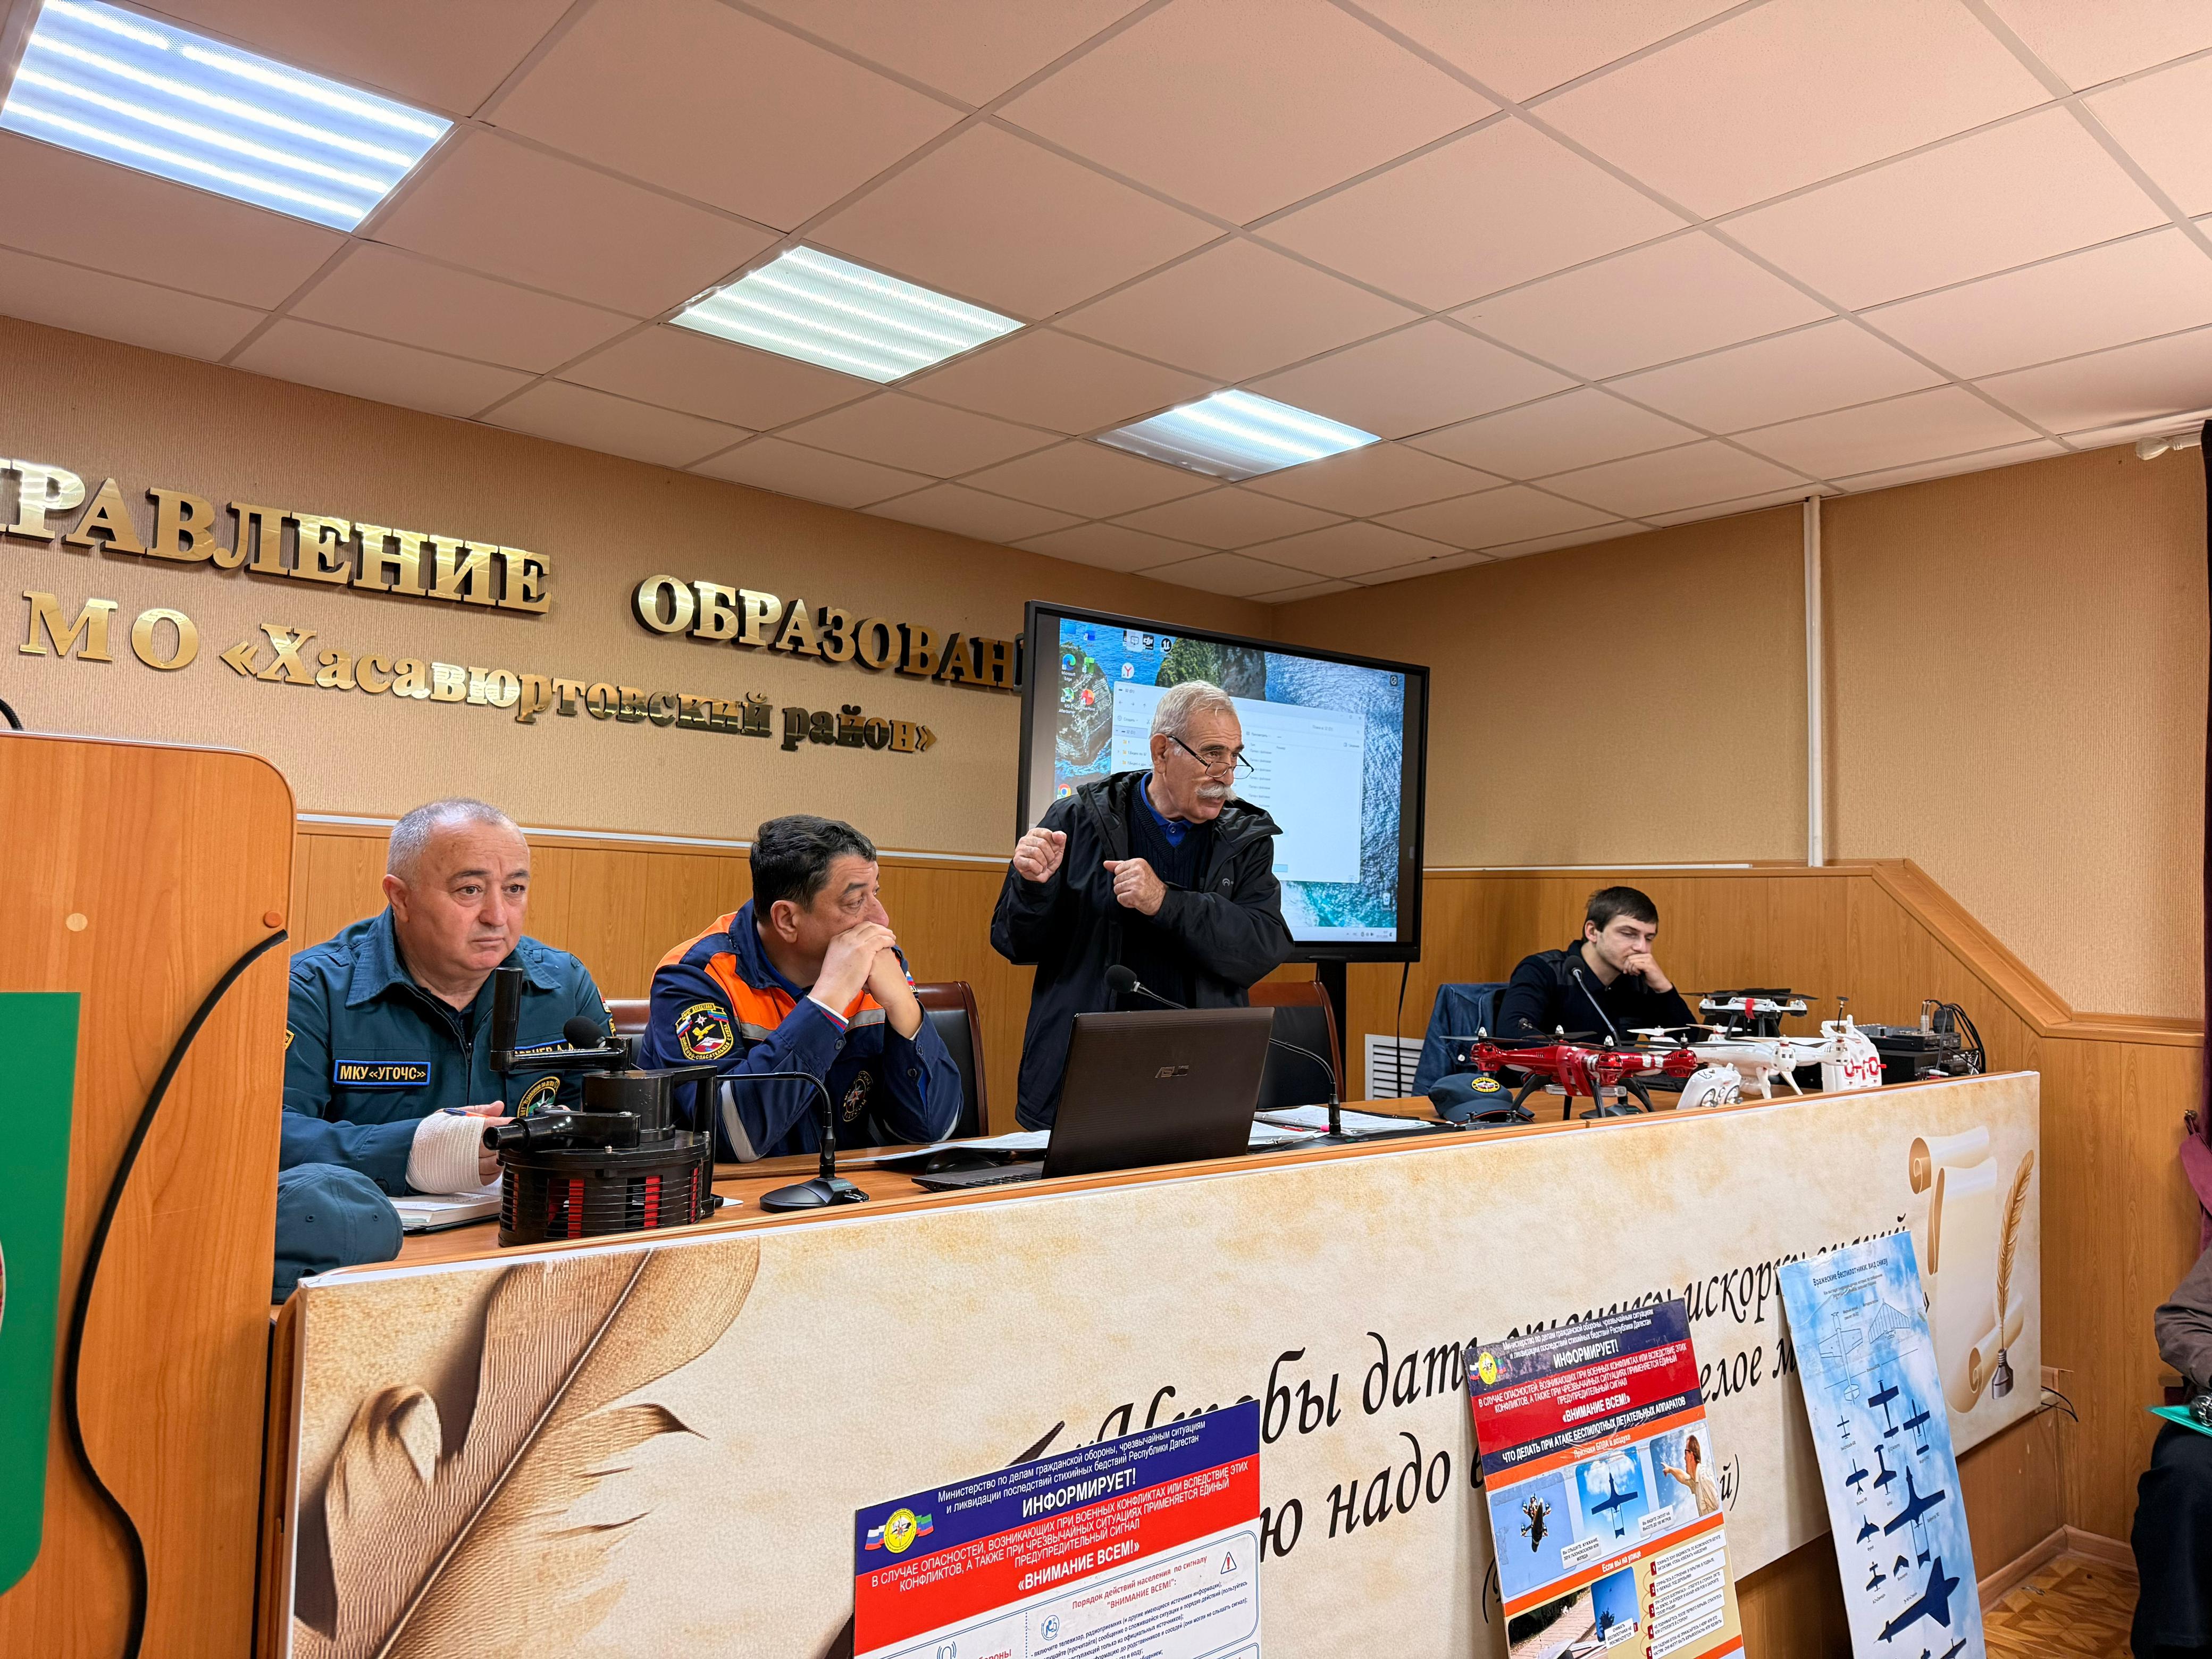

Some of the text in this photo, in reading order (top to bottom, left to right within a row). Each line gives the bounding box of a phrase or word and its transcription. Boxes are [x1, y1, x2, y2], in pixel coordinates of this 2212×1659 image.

[633, 574, 1024, 691] ОБРАЗОВАН
[221, 623, 773, 738] «Хасавюртовский
[781, 704, 937, 752] район»
[1813, 1273, 1837, 1287] Вражеские
[1868, 1261, 1877, 1270] вид
[1877, 1258, 1888, 1267] снизу
[1363, 1332, 1478, 1414] дат
[1685, 1252, 1805, 1323] искор
[1503, 1336, 1534, 1351] Министерство
[1541, 1331, 1555, 1341] делам
[1555, 1323, 1582, 1338] гражданской
[1583, 1320, 1602, 1331] обороны,
[1603, 1313, 1632, 1327] чрезвычайным
[1633, 1309, 1653, 1319] ситуациям
[1514, 1347, 1539, 1358] ликвидации
[1540, 1339, 1568, 1353] последствий
[1568, 1333, 1590, 1345] стихийных
[1591, 1327, 1610, 1338] бедствий
[1610, 1323, 1633, 1335] Республики
[1634, 1319, 1652, 1330] Дагестан
[1554, 1339, 1619, 1368] ИНФОРМИРУЕТ!
[1478, 1399, 1482, 1407] В
[1483, 1393, 1503, 1406] СЛУЧАЕ
[1504, 1384, 1539, 1401] ОПАСНОСТЕЙ,
[1539, 1374, 1576, 1390] ВОЗНИКАЮЩИХ
[1577, 1371, 1587, 1381] ПРИ
[1587, 1364, 1610, 1378] ВОЕННЫХ
[1610, 1357, 1638, 1371] КОНФЛИКТАХ
[1648, 1347, 1675, 1360] ВСЛЕДСТВИЕ
[1675, 1343, 1687, 1352] ЭТИХ
[1495, 1396, 1530, 1413] КОНФЛИКТОВ,
[1534, 1389, 1551, 1402] ТАКЖЕ
[1551, 1387, 1561, 1397] ПРИ
[1561, 1374, 1601, 1393] ЧРЕЗВЫЧАЙНЫХ
[1601, 1369, 1627, 1383] СИТУАЦИЯХ
[1627, 1360, 1659, 1376] ПРИМЕНЯЕТСЯ
[1659, 1354, 1677, 1367] ЕДИНЫЙ
[1557, 1378, 1627, 1404] ПРЕДУПРЕДИТЕЛЬНЫЙ СИГНАЛ
[1502, 1396, 1686, 1463] ЧТО ДЕЛАТЬ ПРИ АТАКЕ БЕСПИЛОТНЫХ ЛЕТАТЕЛЬНЫХ АППАРАТОВ
[1563, 1393, 1630, 1422] «ВНИМАНИЕ ВСЕМ!»
[938, 1421, 1205, 1503] Министерство по делам гражданской обороны, чрезвычайным ситуациям
[1595, 1439, 1609, 1451] БПЛА
[1613, 1434, 1631, 1445] воздухе
[946, 1435, 1199, 1514] и ликвидации последствий стихийных бедствий Республики Дагестан
[1023, 1468, 1136, 1518] ИНФОРМИРУЕТ!
[1326, 1432, 1450, 1539] надо
[872, 1461, 1249, 1587] В СЛУЧАЕ ОПАСНОСТЕЙ, ВОЗНИКАЮЩИХ ПРИ ВОЕННЫХ КОНФЛИКТАХ ИЛИ ВСЛЕДСТВИЕ ЭТИХ
[900, 1478, 1229, 1592] КОНФЛИКТОВ, А ТАКЖЕ ПРИ ЧРЕЗВЫЧАЙНЫХ СИТУАЦИЯХ ПРИМЕНЯЕТСЯ ЕДИНЫЙ
[1015, 1519, 1139, 1568] ПРЕДУПРЕДИТЕЛЬНЫЙ СИГНАЛ
[1018, 1539, 1139, 1591] «ВНИМАНИЕ ВСЕМ!»
[1073, 1594, 1103, 1610] Порядок
[1104, 1580, 1135, 1599] действий
[1137, 1569, 1170, 1586] населения
[1183, 1556, 1207, 1570] сигналу
[1602, 1561, 1613, 1572] Если
[1614, 1560, 1621, 1568] вы
[1628, 1551, 1641, 1563] улице
[1067, 1637, 1097, 1655] (прочитайте)
[1098, 1629, 1124, 1642] сообщение
[1128, 1615, 1159, 1630] сложившейся
[1160, 1607, 1179, 1619] ситуации
[1184, 1599, 1201, 1611] порядке
[1202, 1590, 1220, 1603] действий
[1221, 1581, 1247, 1596] (пользуйтесь
[1108, 1578, 1176, 1608] "ВНИМАНИЕ ВСЕМ!":
[1034, 1644, 1058, 1657] включите
[1059, 1634, 1085, 1648] телевизор,
[1128, 1612, 1143, 1622] другие
[1144, 1602, 1169, 1615] имеющиеся
[1170, 1593, 1193, 1605] источники
[1101, 1640, 1117, 1652] только
[1124, 1626, 1155, 1644] официальных
[1127, 1632, 1160, 1652] родственников
[1166, 1622, 1183, 1634] соседей
[1212, 1604, 1231, 1615] слышать
